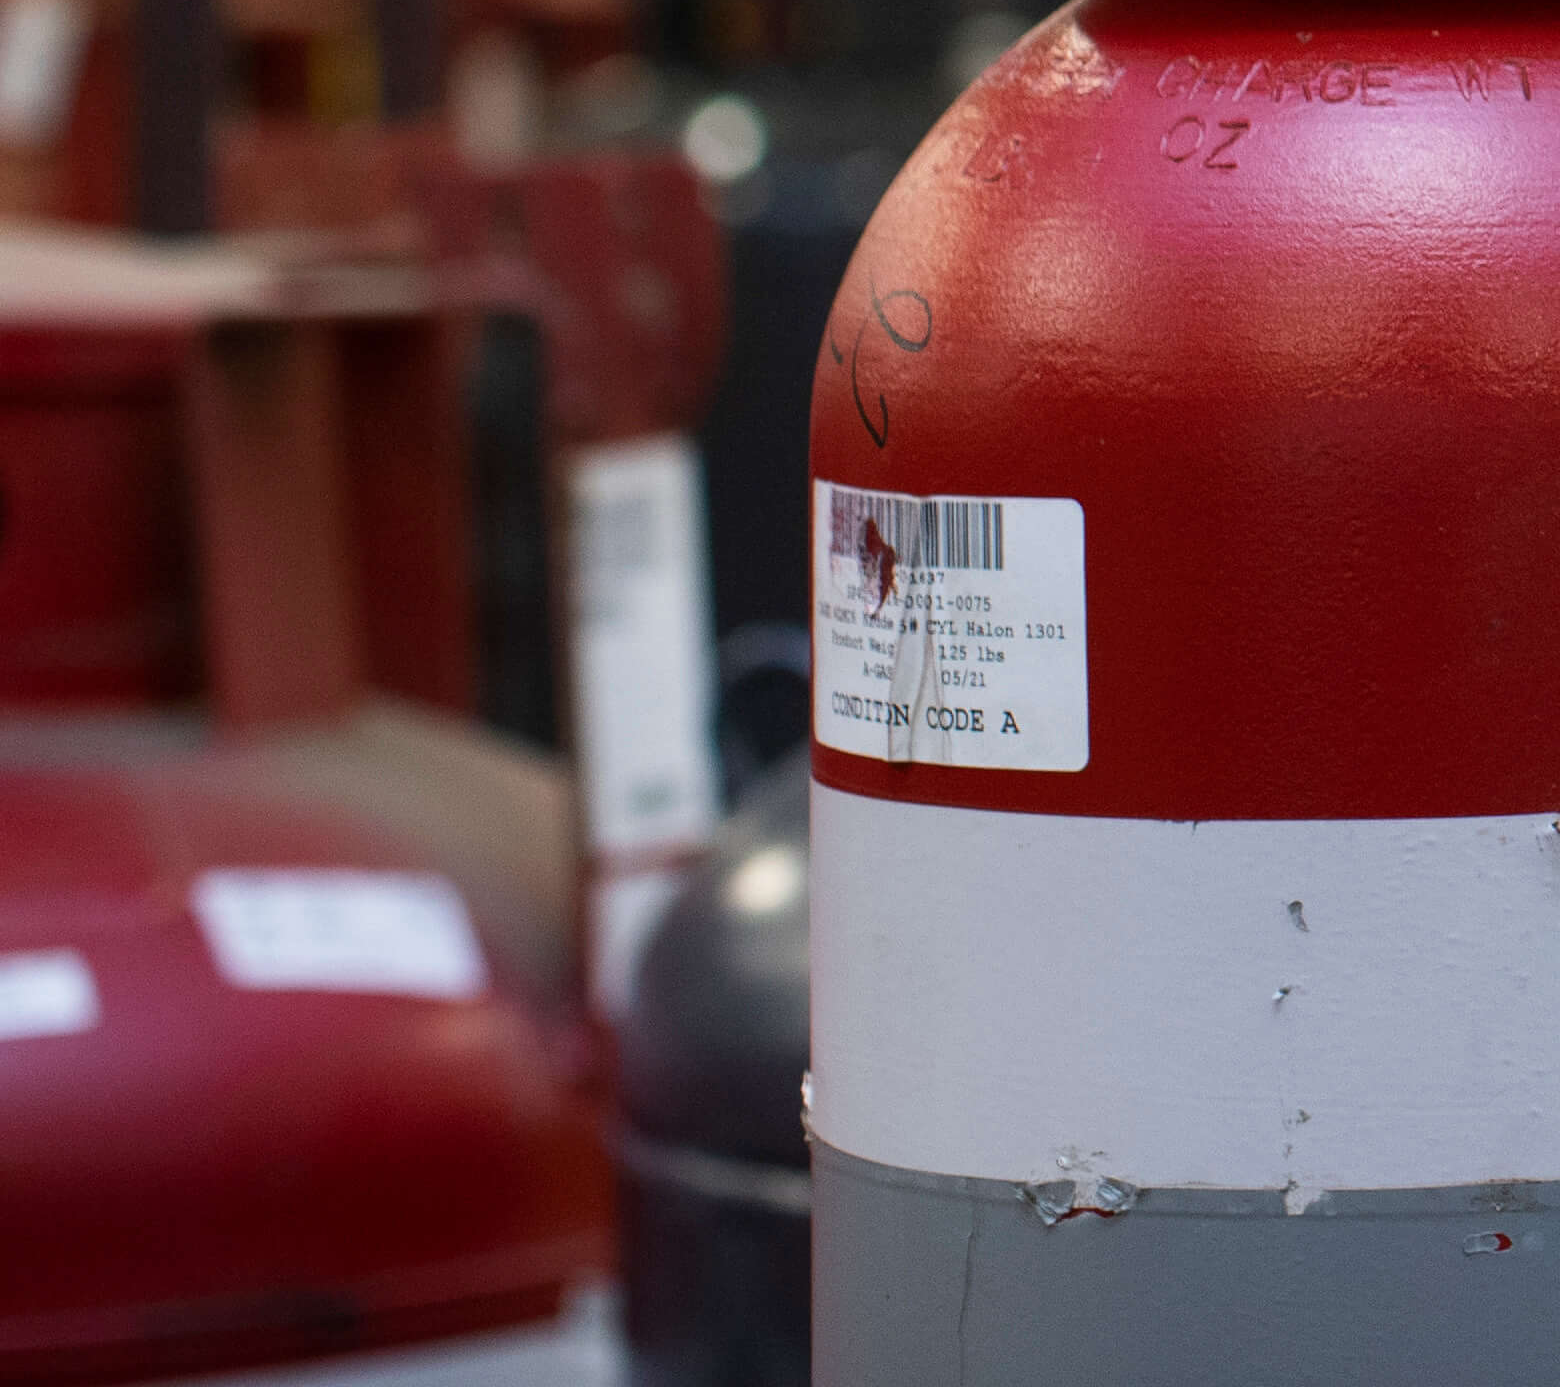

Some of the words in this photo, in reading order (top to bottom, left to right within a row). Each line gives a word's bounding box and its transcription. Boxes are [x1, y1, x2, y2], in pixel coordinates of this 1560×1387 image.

[1155, 54, 1398, 109] CHARGE
[1448, 57, 1535, 104] WT
[1159, 114, 1251, 171] OZ
[966, 621, 1015, 639] Halon
[1025, 623, 1066, 640] 1301
[937, 644, 968, 661] 125
[977, 645, 1006, 663] lbs
[926, 705, 985, 733] CODE
[1000, 710, 1021, 735] A
